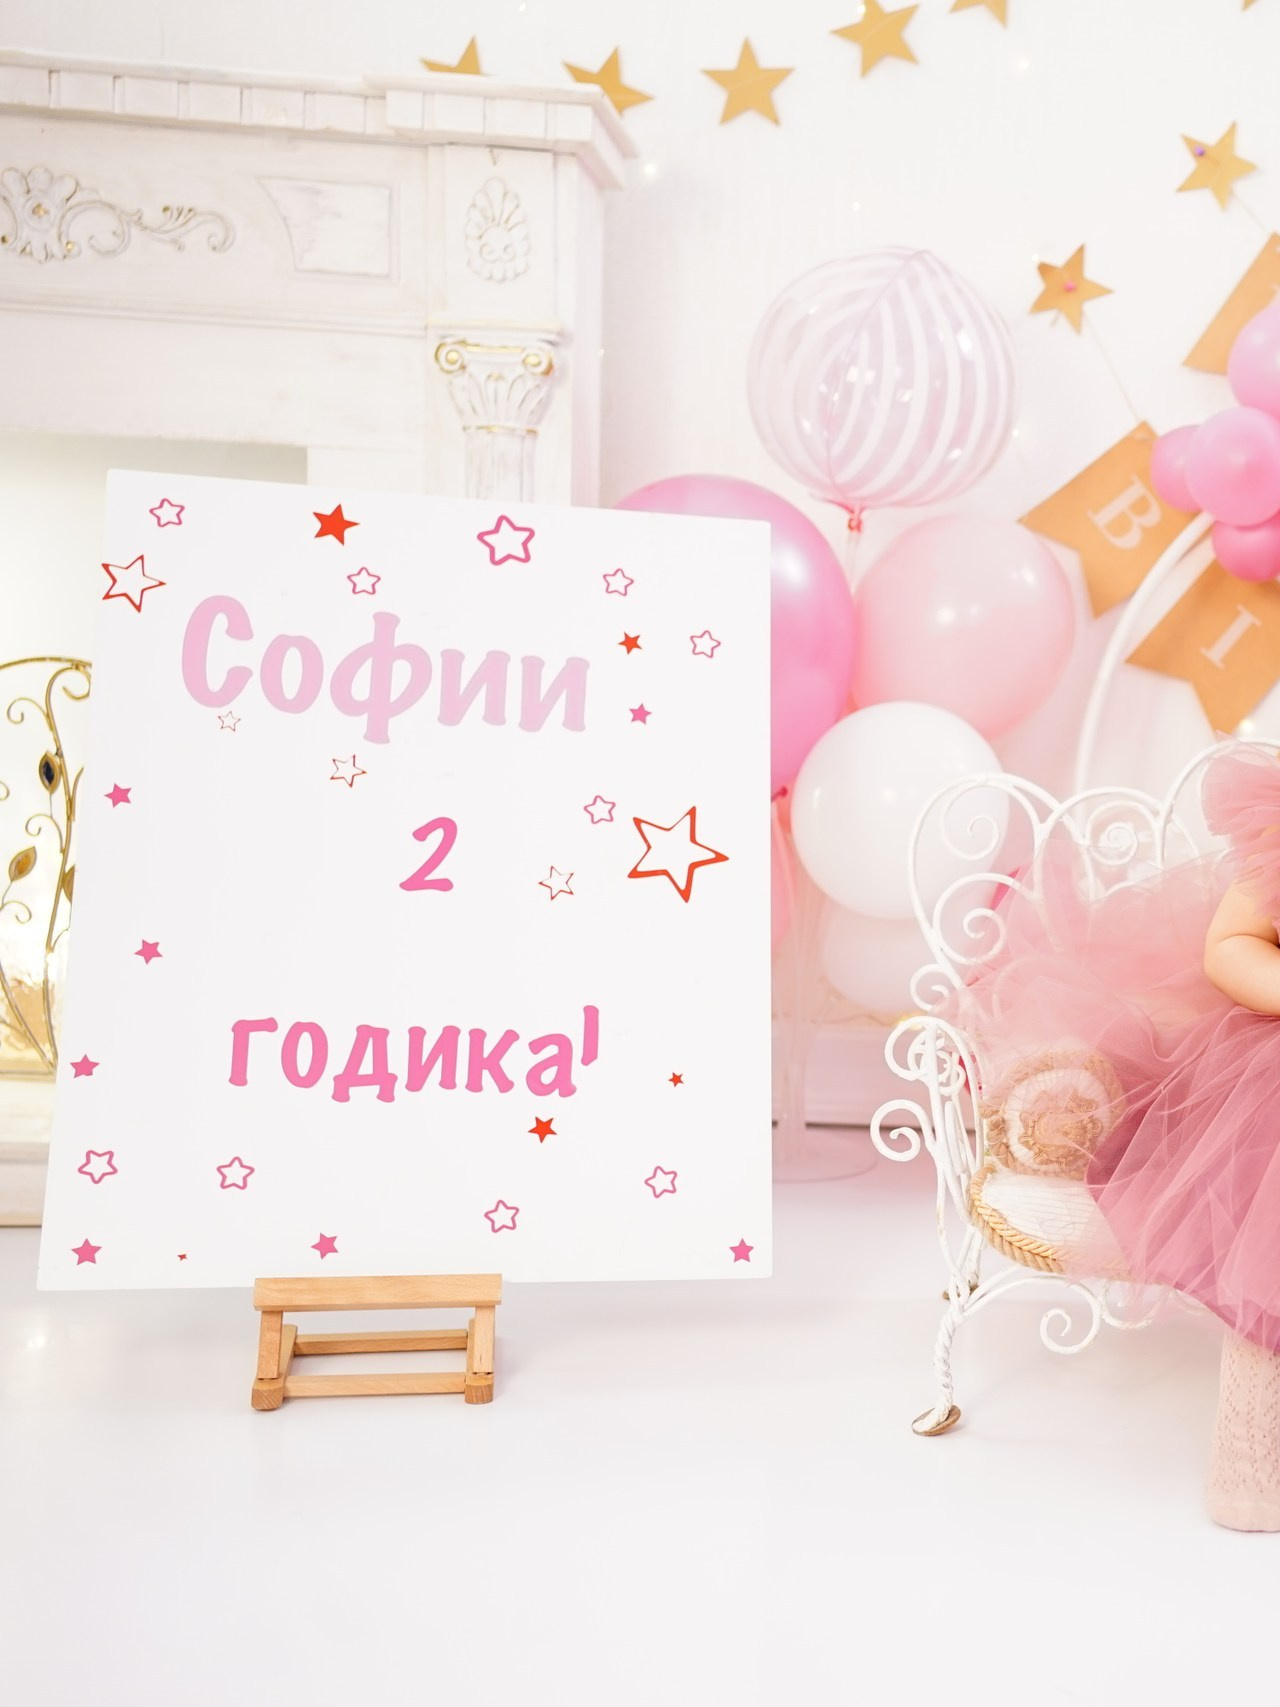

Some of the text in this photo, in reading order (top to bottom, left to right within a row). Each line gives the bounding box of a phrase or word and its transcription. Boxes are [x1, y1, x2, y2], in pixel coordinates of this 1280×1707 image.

[1086, 474, 1163, 550] B
[181, 595, 590, 744] Софии
[399, 816, 459, 893] 2
